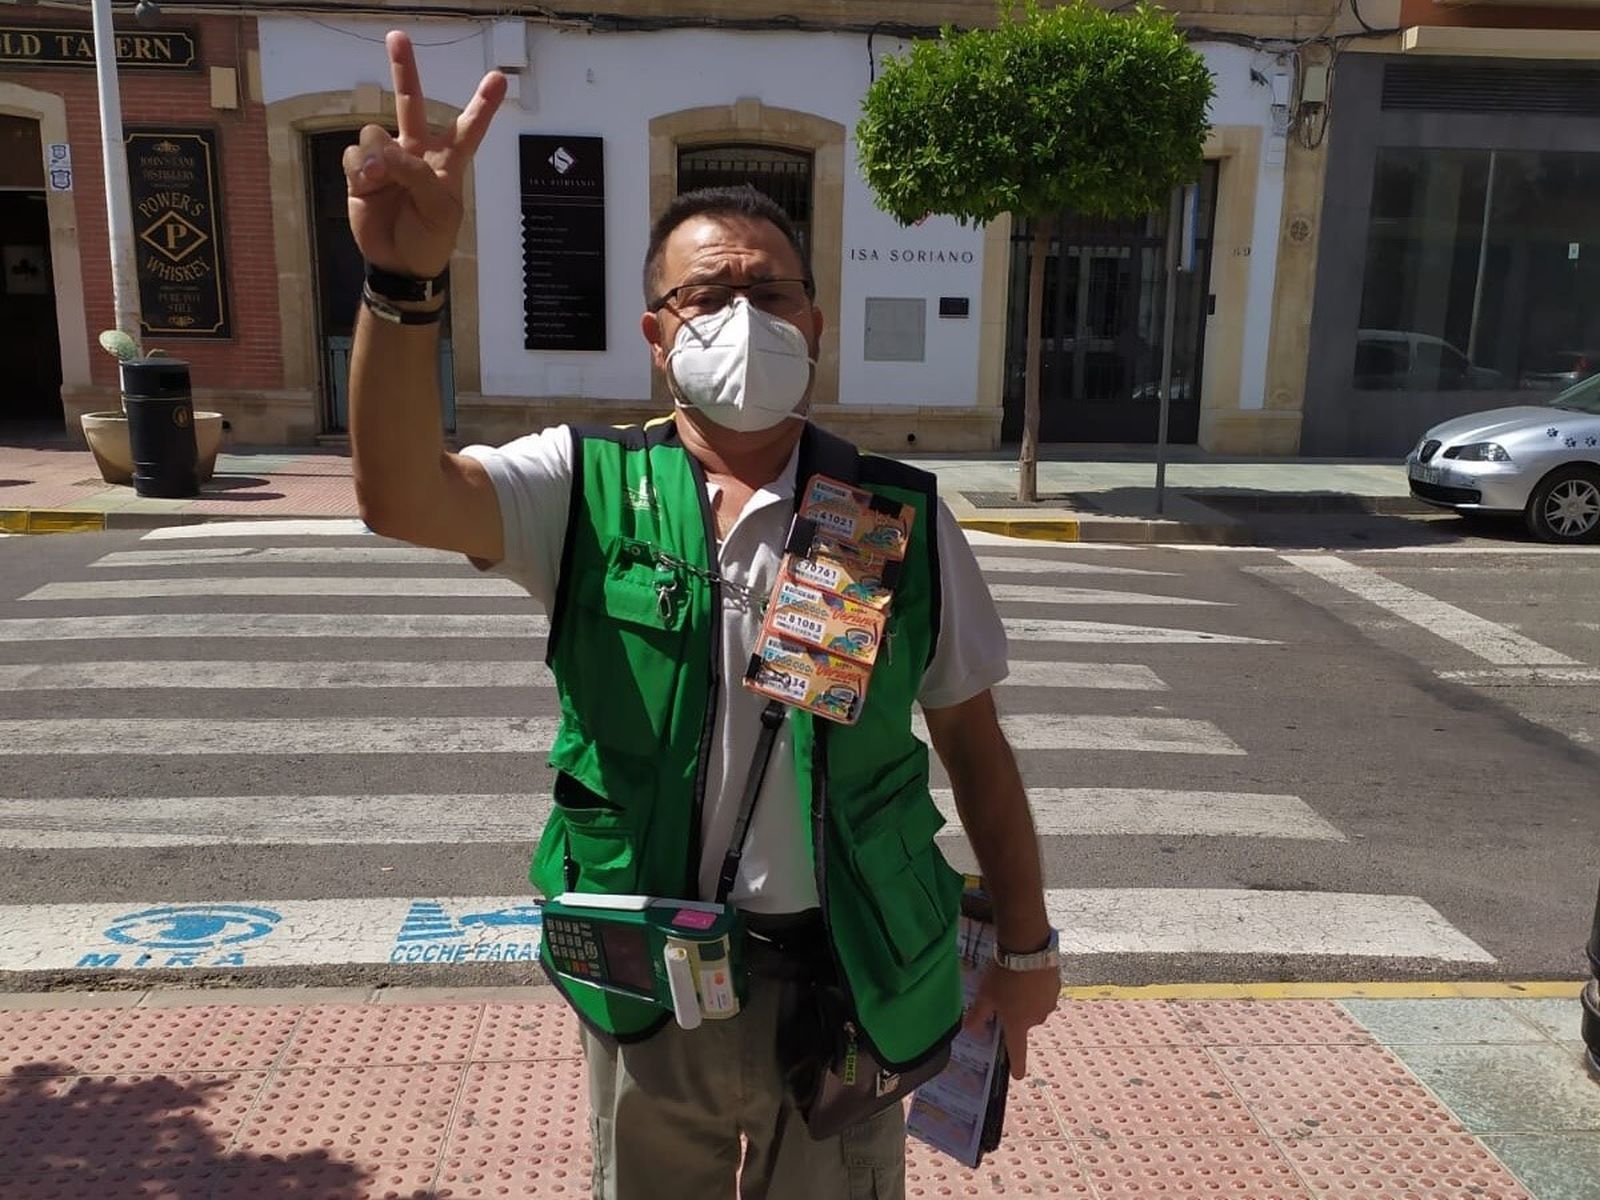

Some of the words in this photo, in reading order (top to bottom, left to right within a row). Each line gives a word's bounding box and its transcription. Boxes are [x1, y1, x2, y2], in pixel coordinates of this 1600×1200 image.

[56, 35, 172, 59] TAERN
[166, 223, 188, 249] P
[851, 249, 879, 261] ISA
[889, 249, 974, 264] SORIANO
[146, 256, 211, 282] WHISKEY
[76, 952, 247, 968] MIRA
[389, 943, 469, 963] COCHE
